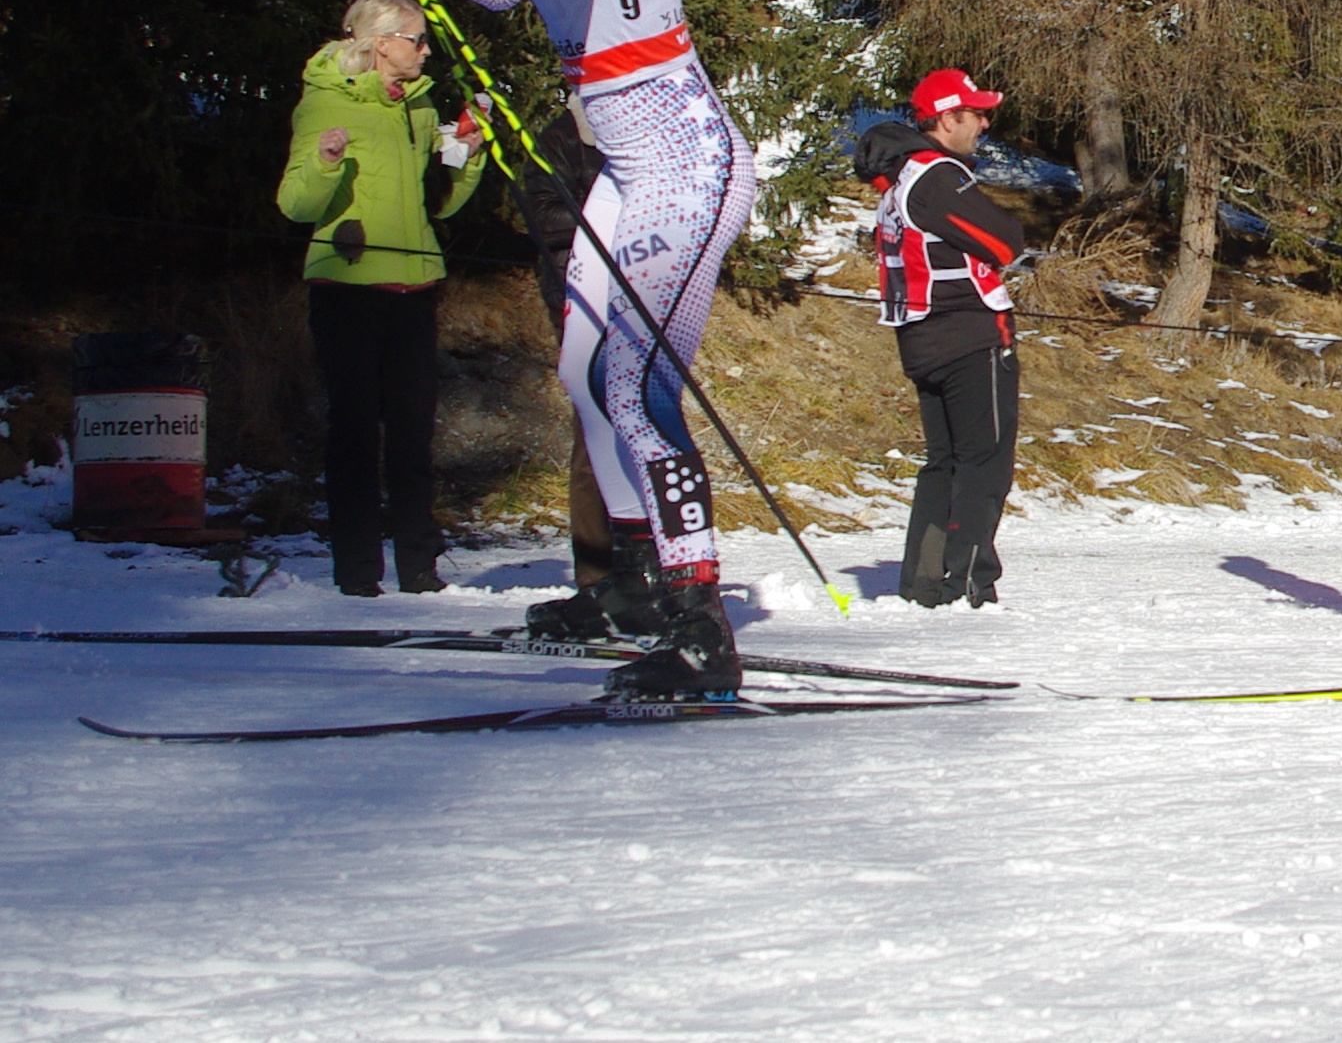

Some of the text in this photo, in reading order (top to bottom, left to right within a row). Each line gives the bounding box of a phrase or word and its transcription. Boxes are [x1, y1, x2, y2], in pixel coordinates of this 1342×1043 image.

[679, 502, 707, 532] 9
[501, 641, 585, 657] salomon
[605, 706, 674, 718] salomon
